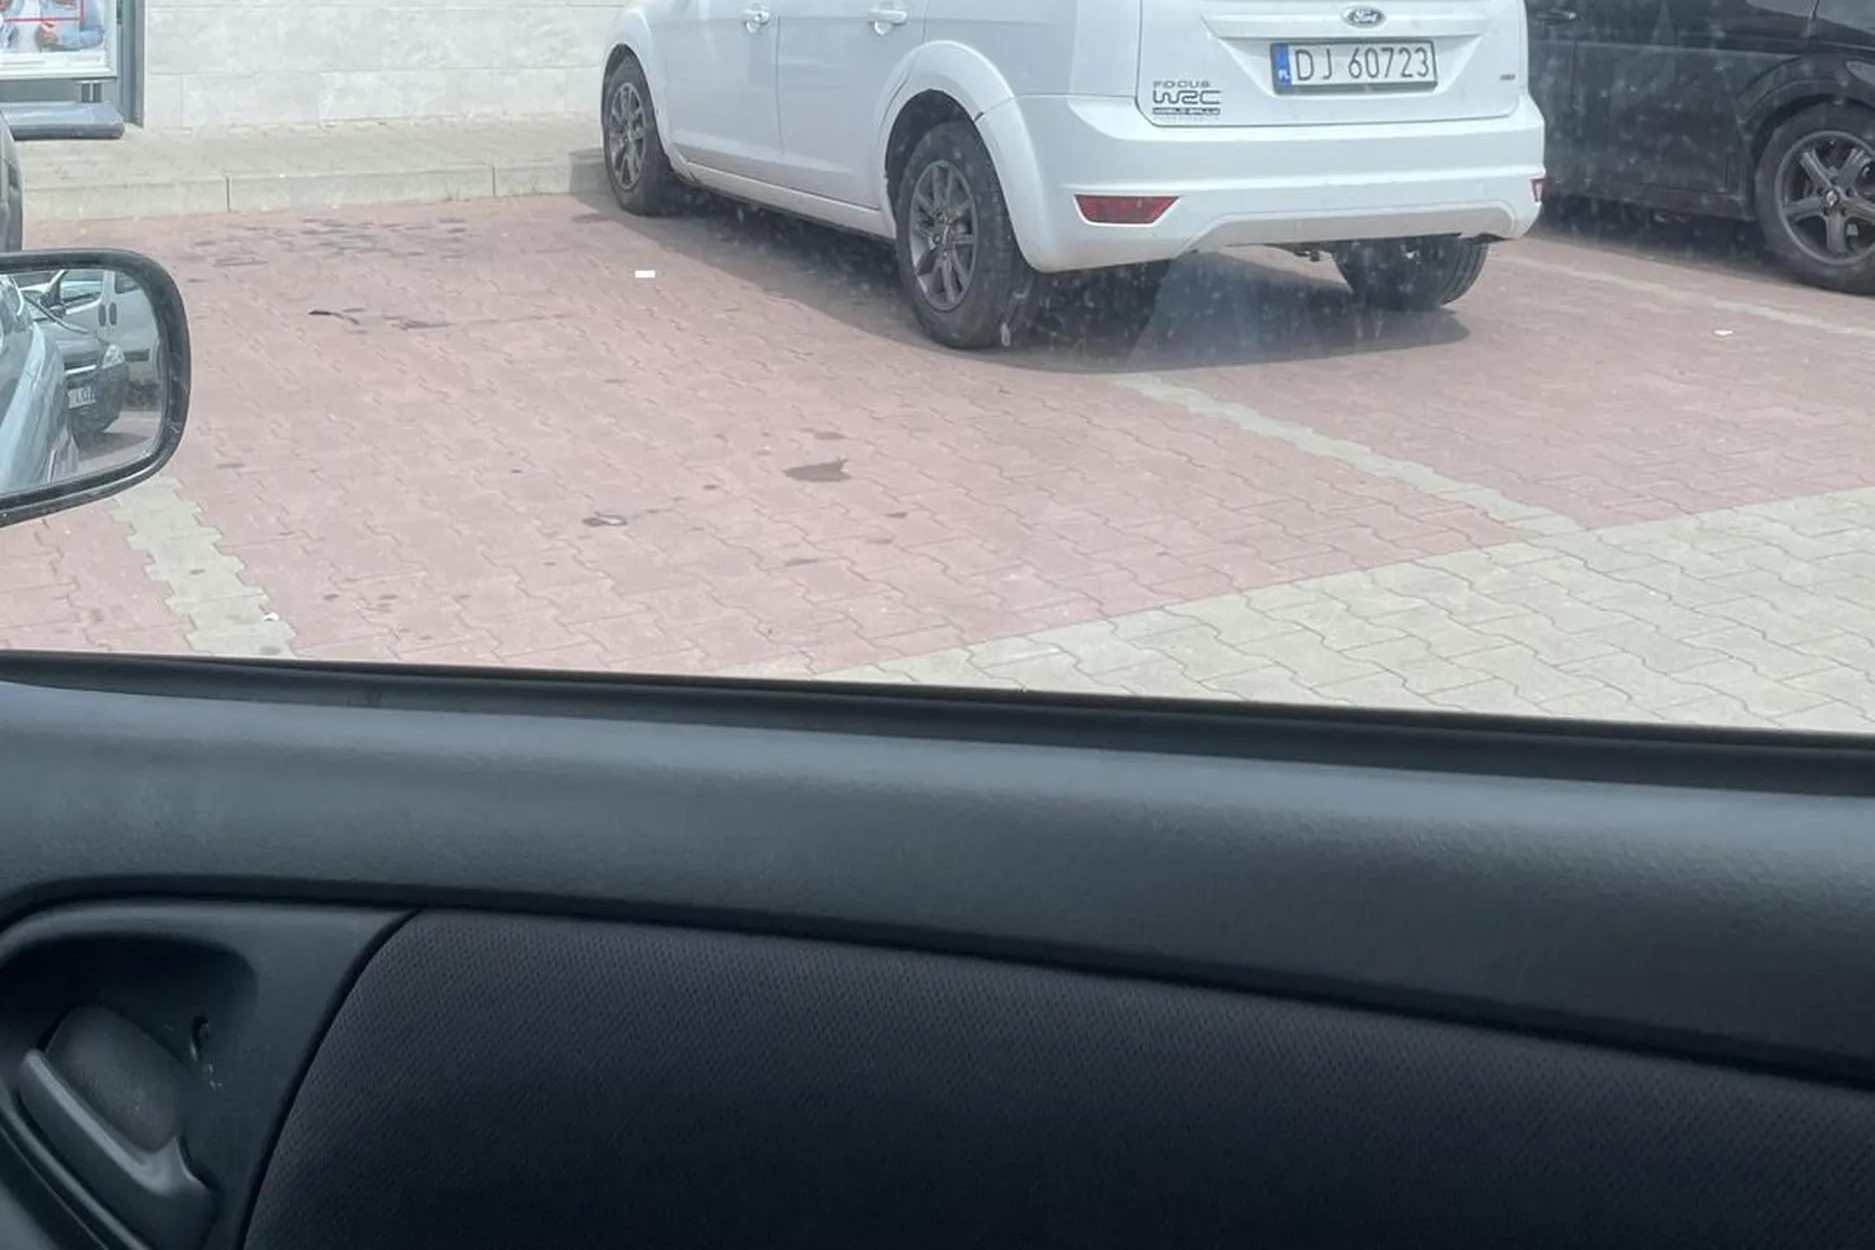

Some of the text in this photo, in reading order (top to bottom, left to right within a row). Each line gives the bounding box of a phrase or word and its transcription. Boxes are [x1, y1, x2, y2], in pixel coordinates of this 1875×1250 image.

[1349, 8, 1381, 24] Ford
[1295, 46, 1430, 81] DJ 60723
[1153, 80, 1210, 89] FOCUS
[1153, 90, 1222, 105] WRC
